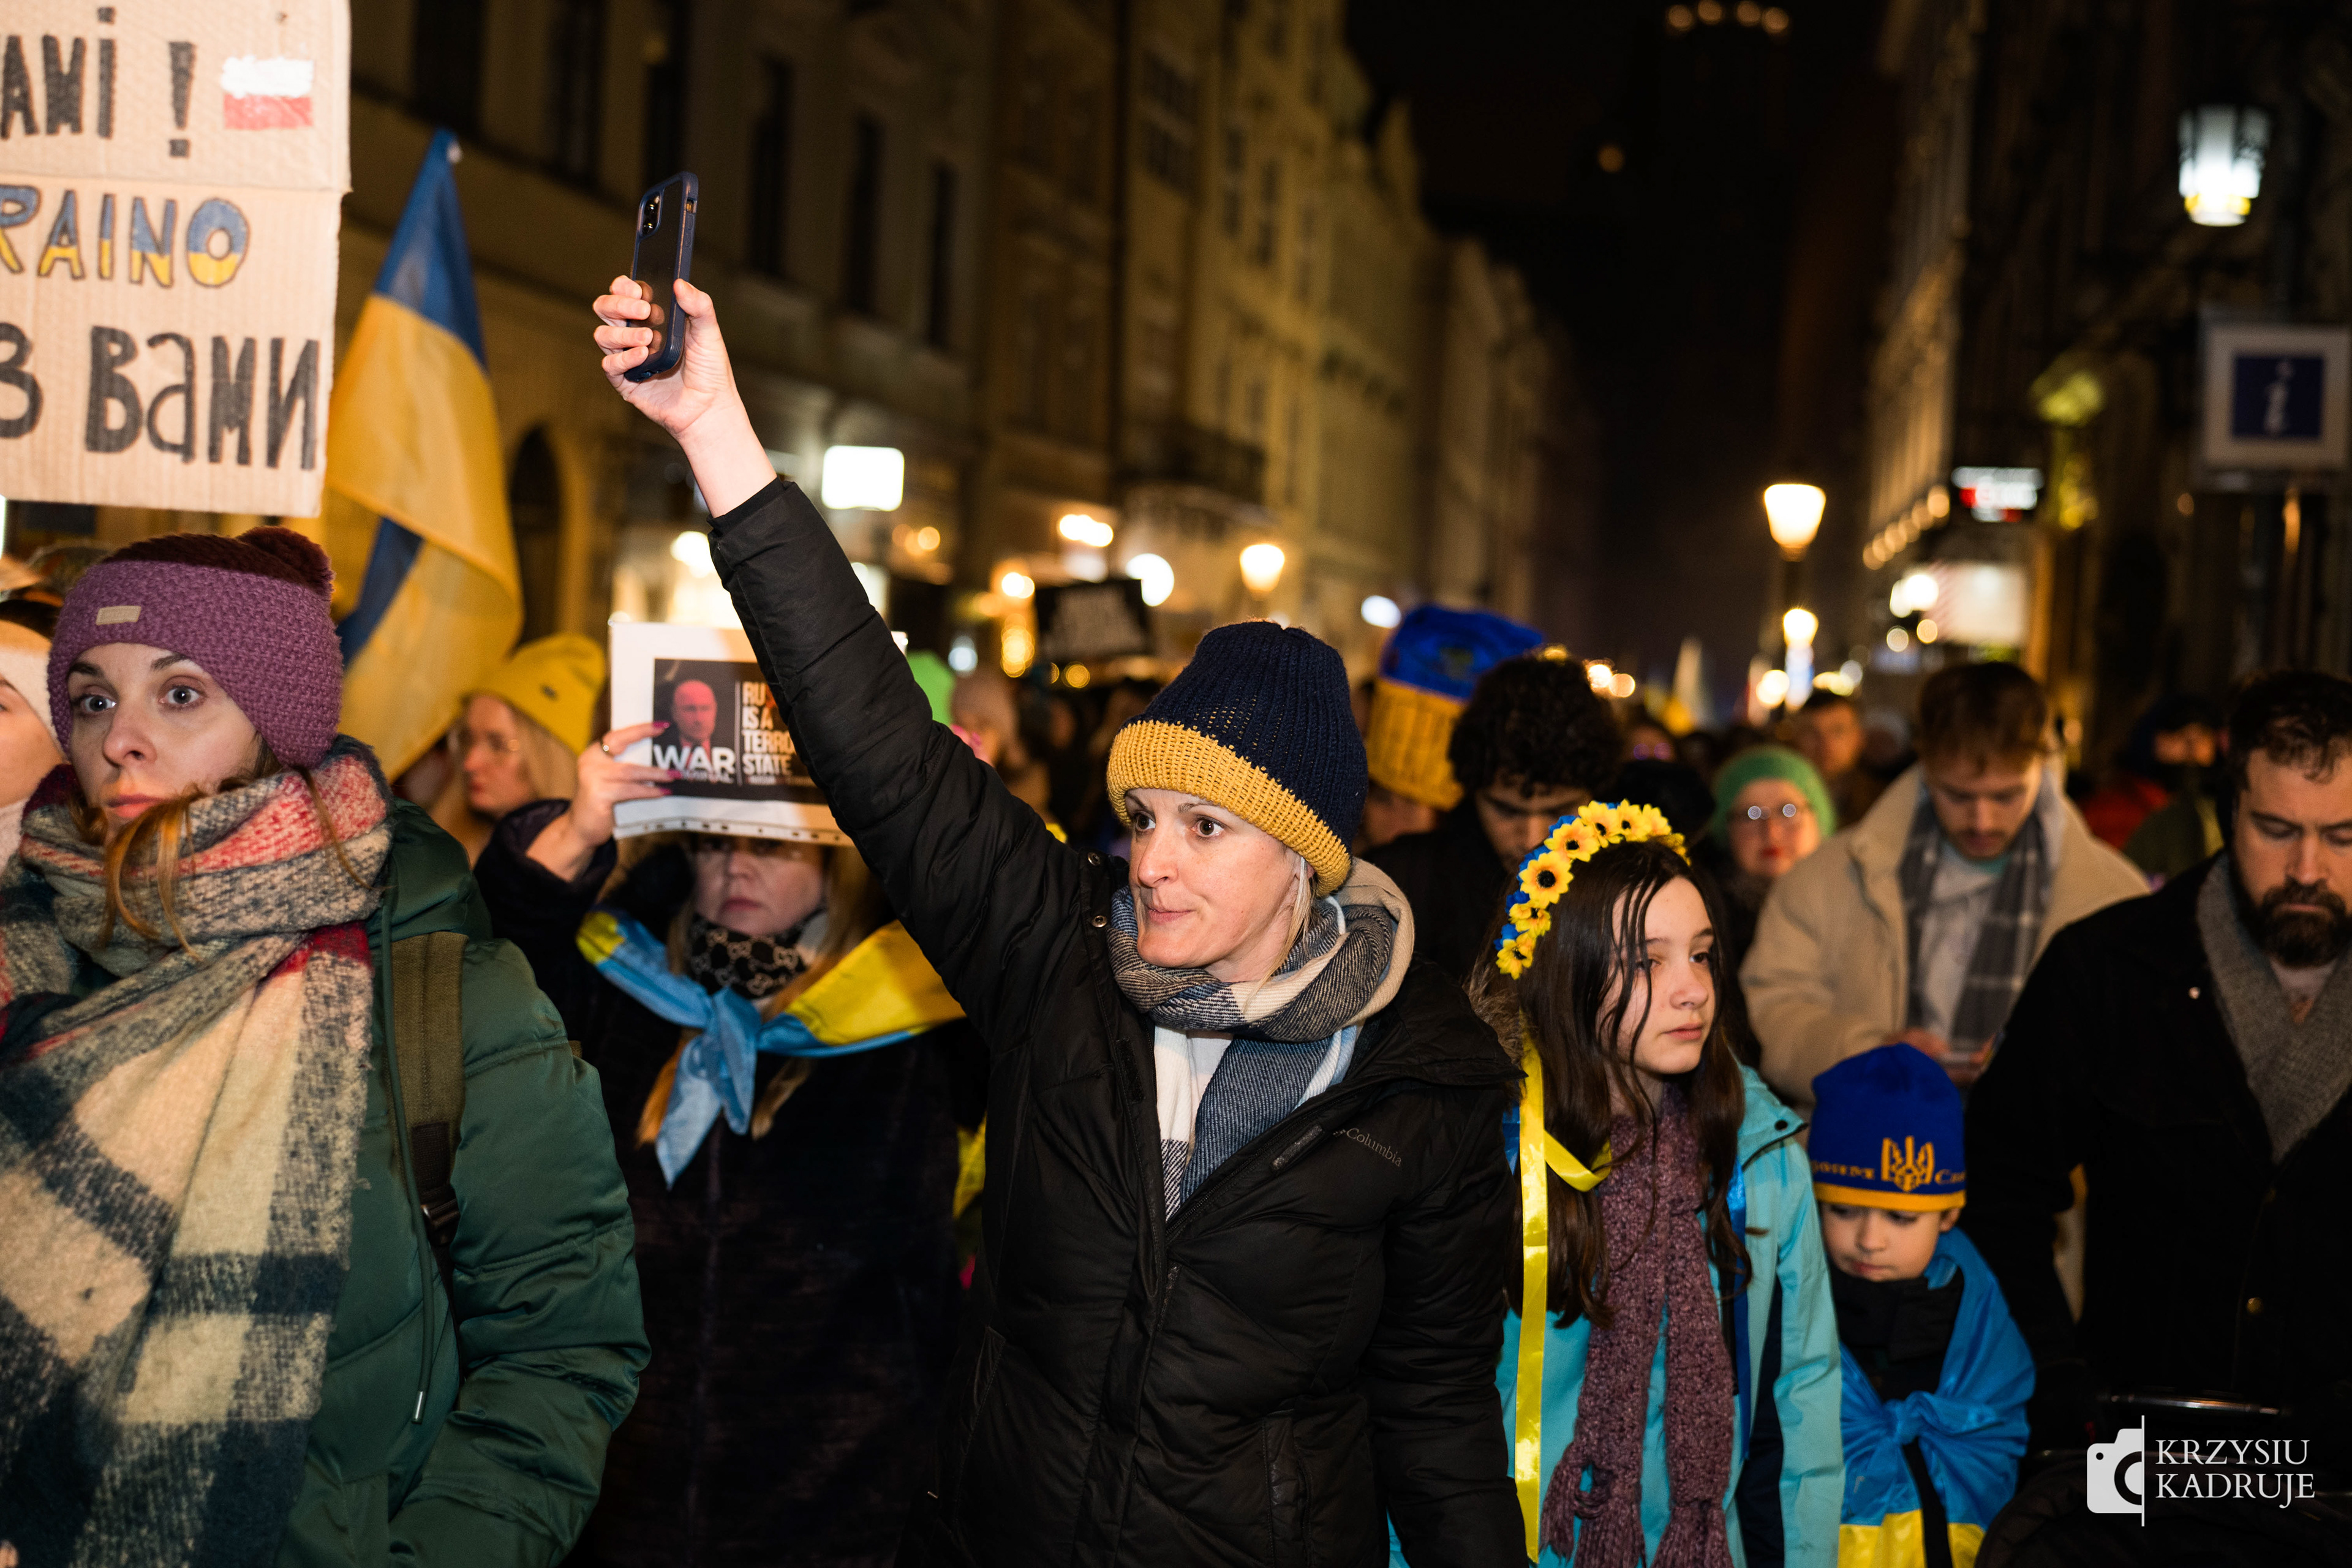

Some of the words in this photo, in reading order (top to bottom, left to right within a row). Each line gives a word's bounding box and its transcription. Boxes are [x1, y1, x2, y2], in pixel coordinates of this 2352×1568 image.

[168, 41, 196, 157] !
[742, 706, 760, 729] IS
[760, 706, 774, 729] A
[653, 744, 735, 775] WAR
[742, 753, 791, 775] STATE
[1347, 1128, 1402, 1167] Columbia
